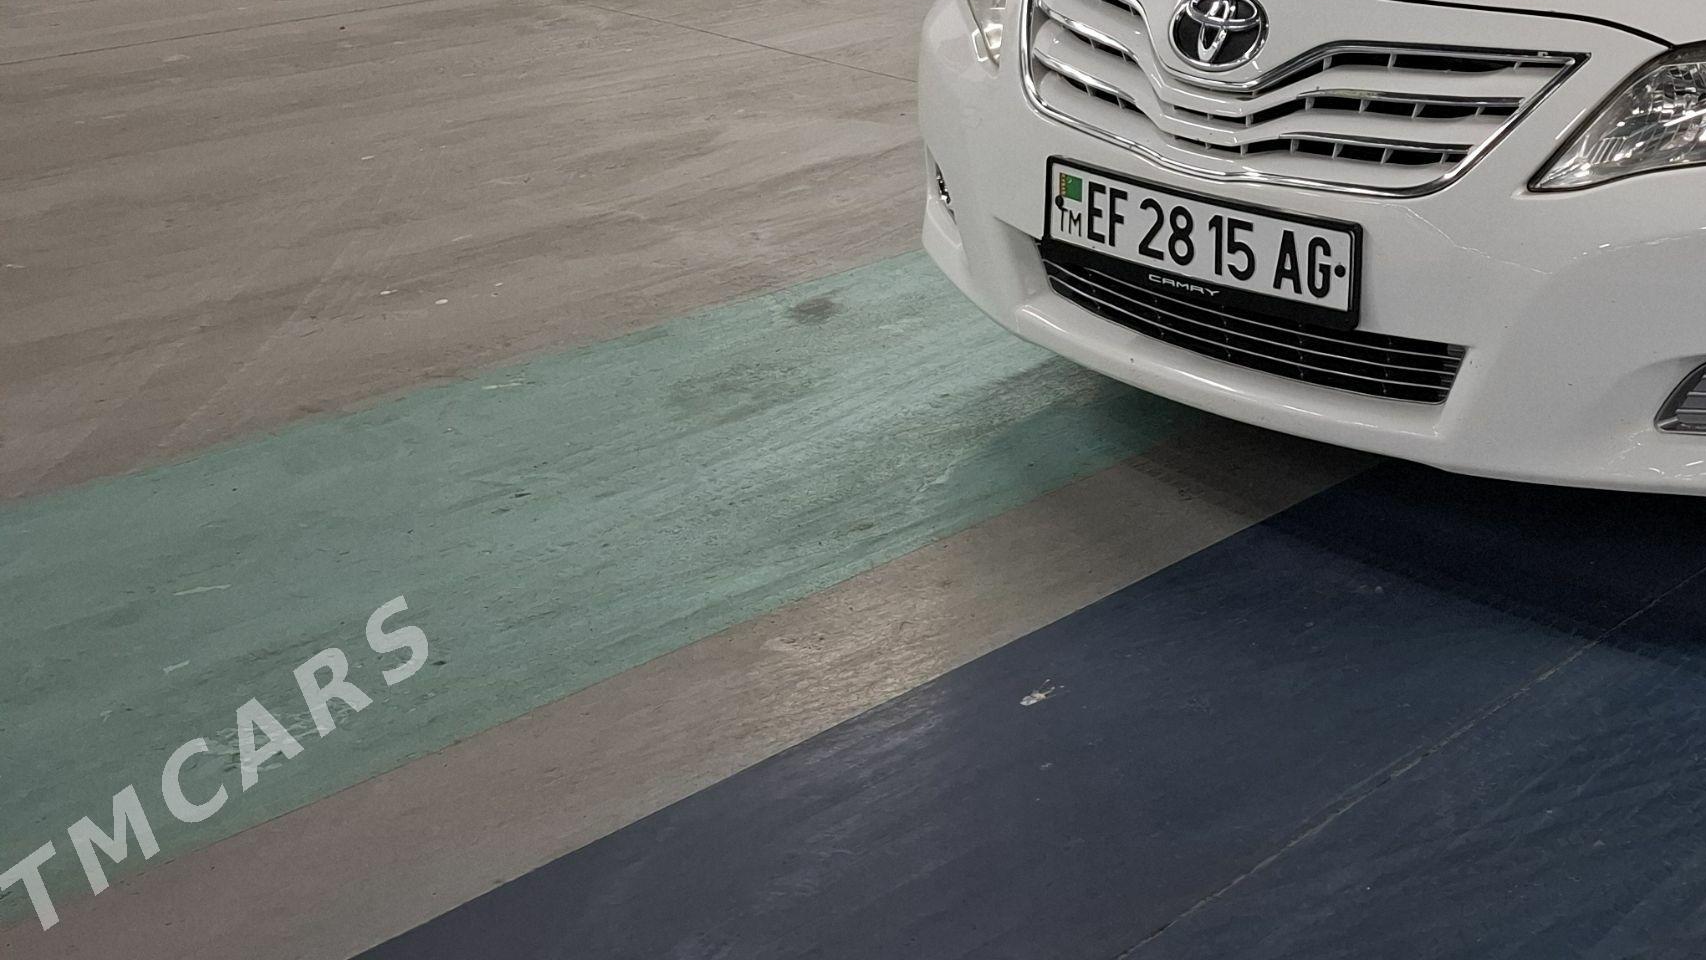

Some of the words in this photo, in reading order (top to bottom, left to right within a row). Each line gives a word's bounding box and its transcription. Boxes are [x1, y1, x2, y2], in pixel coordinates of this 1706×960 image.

[1059, 205, 1081, 237] TM
[1087, 181, 1128, 247] EF
[1138, 198, 1194, 266] 28
[1208, 214, 1256, 281] 15
[1273, 229, 1332, 299] AG
[1148, 273, 1220, 296] CAMRY
